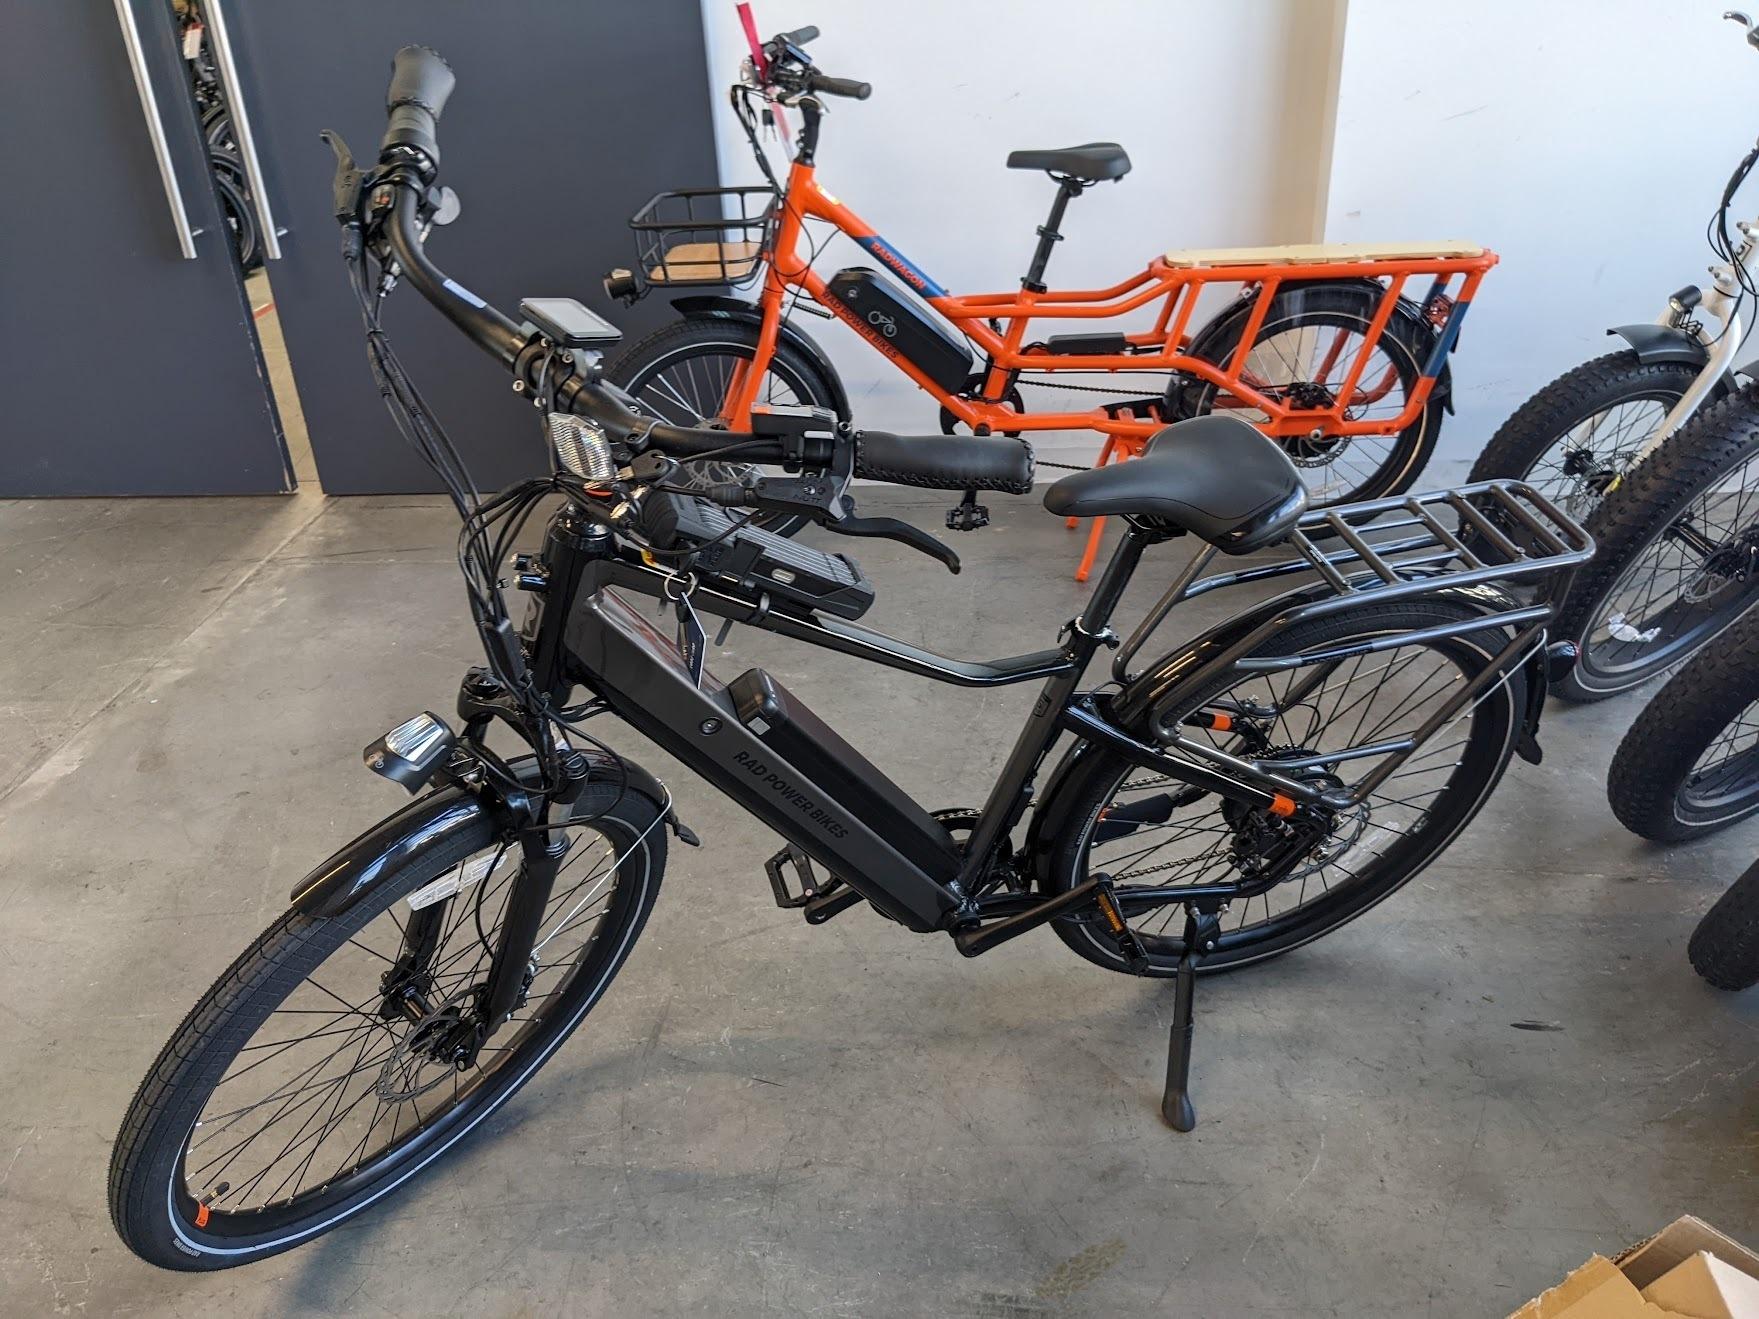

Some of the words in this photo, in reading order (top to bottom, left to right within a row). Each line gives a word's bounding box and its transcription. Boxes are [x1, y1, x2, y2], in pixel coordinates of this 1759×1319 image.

[870, 243, 926, 289] RADWAGON
[822, 290, 841, 310] RAD
[841, 307, 873, 337] POWER
[871, 334, 899, 358] BIKES
[733, 750, 767, 776] RAD
[762, 773, 815, 813] POWER
[809, 809, 849, 839] BIKES
